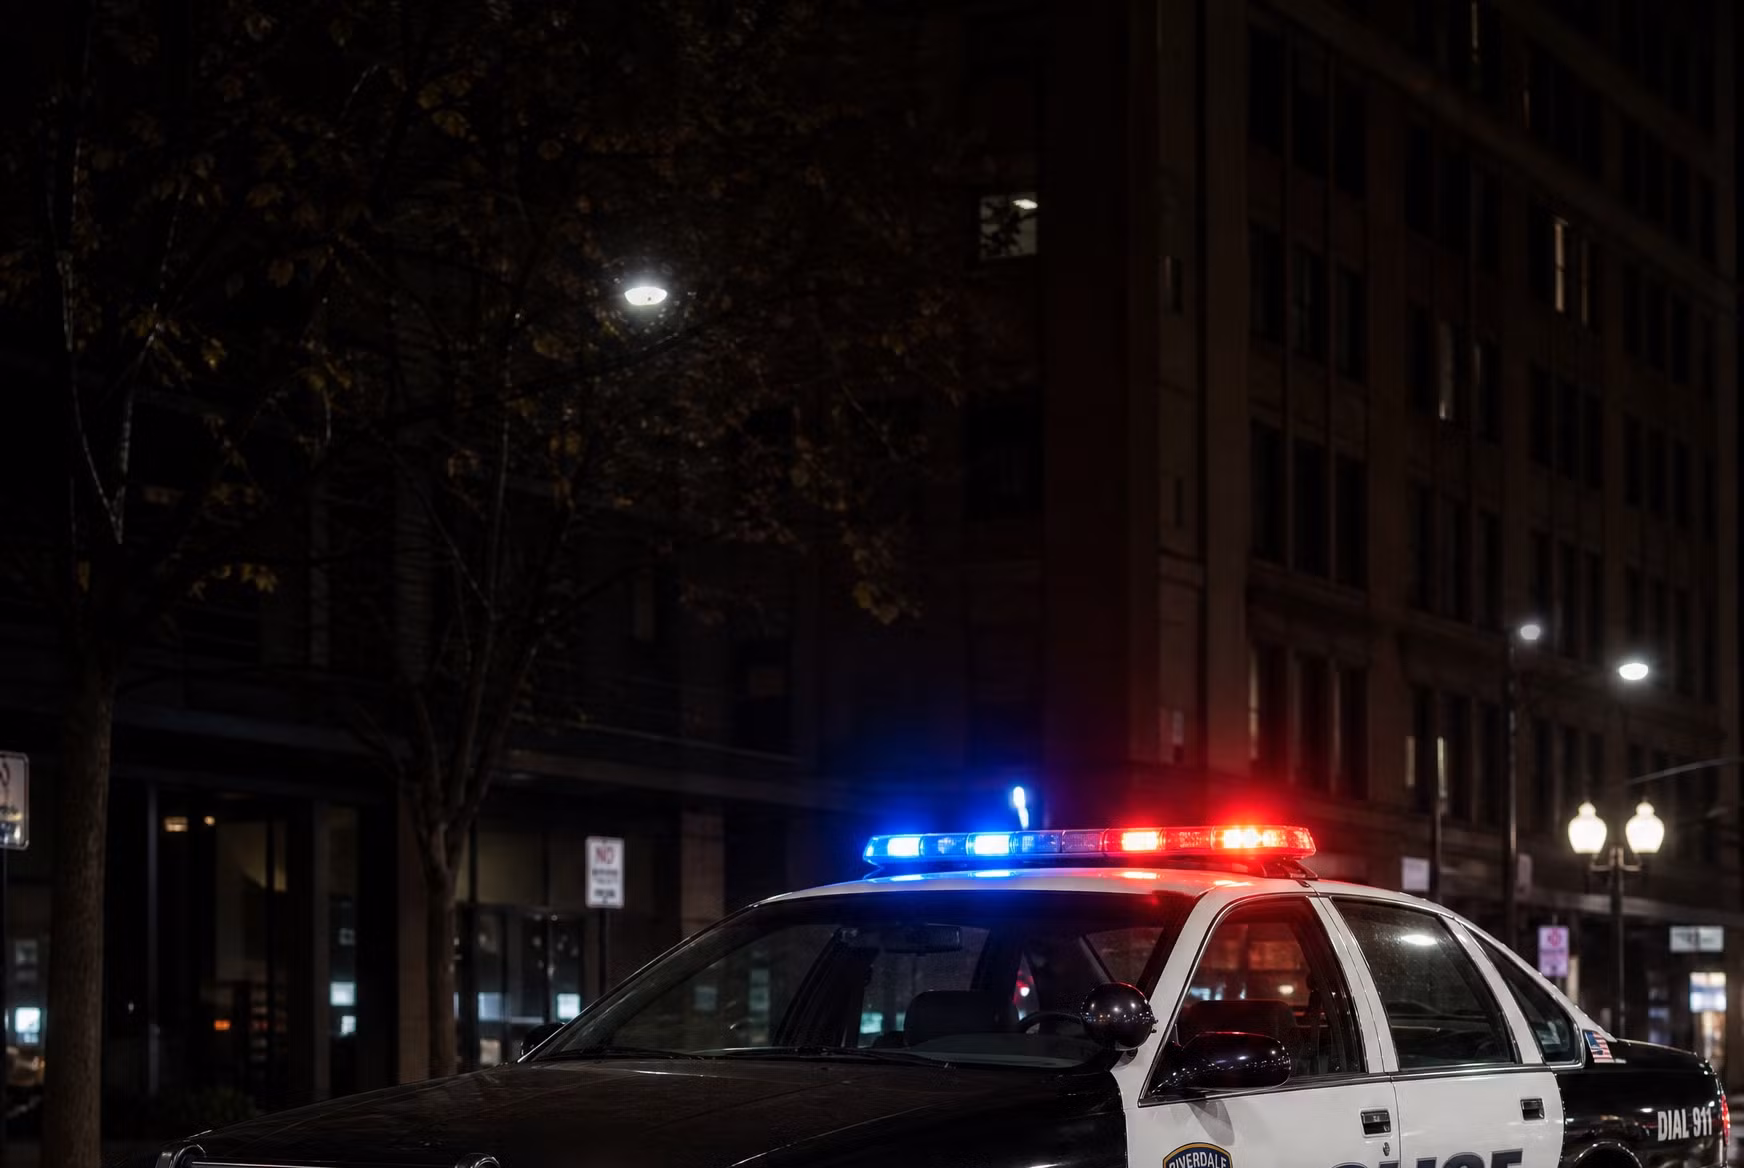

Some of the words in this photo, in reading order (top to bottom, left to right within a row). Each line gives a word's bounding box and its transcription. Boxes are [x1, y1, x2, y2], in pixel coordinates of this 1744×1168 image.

[595, 847, 614, 864] NO
[1658, 1109, 1689, 1142] DIAL
[1692, 1107, 1712, 1137] 911
